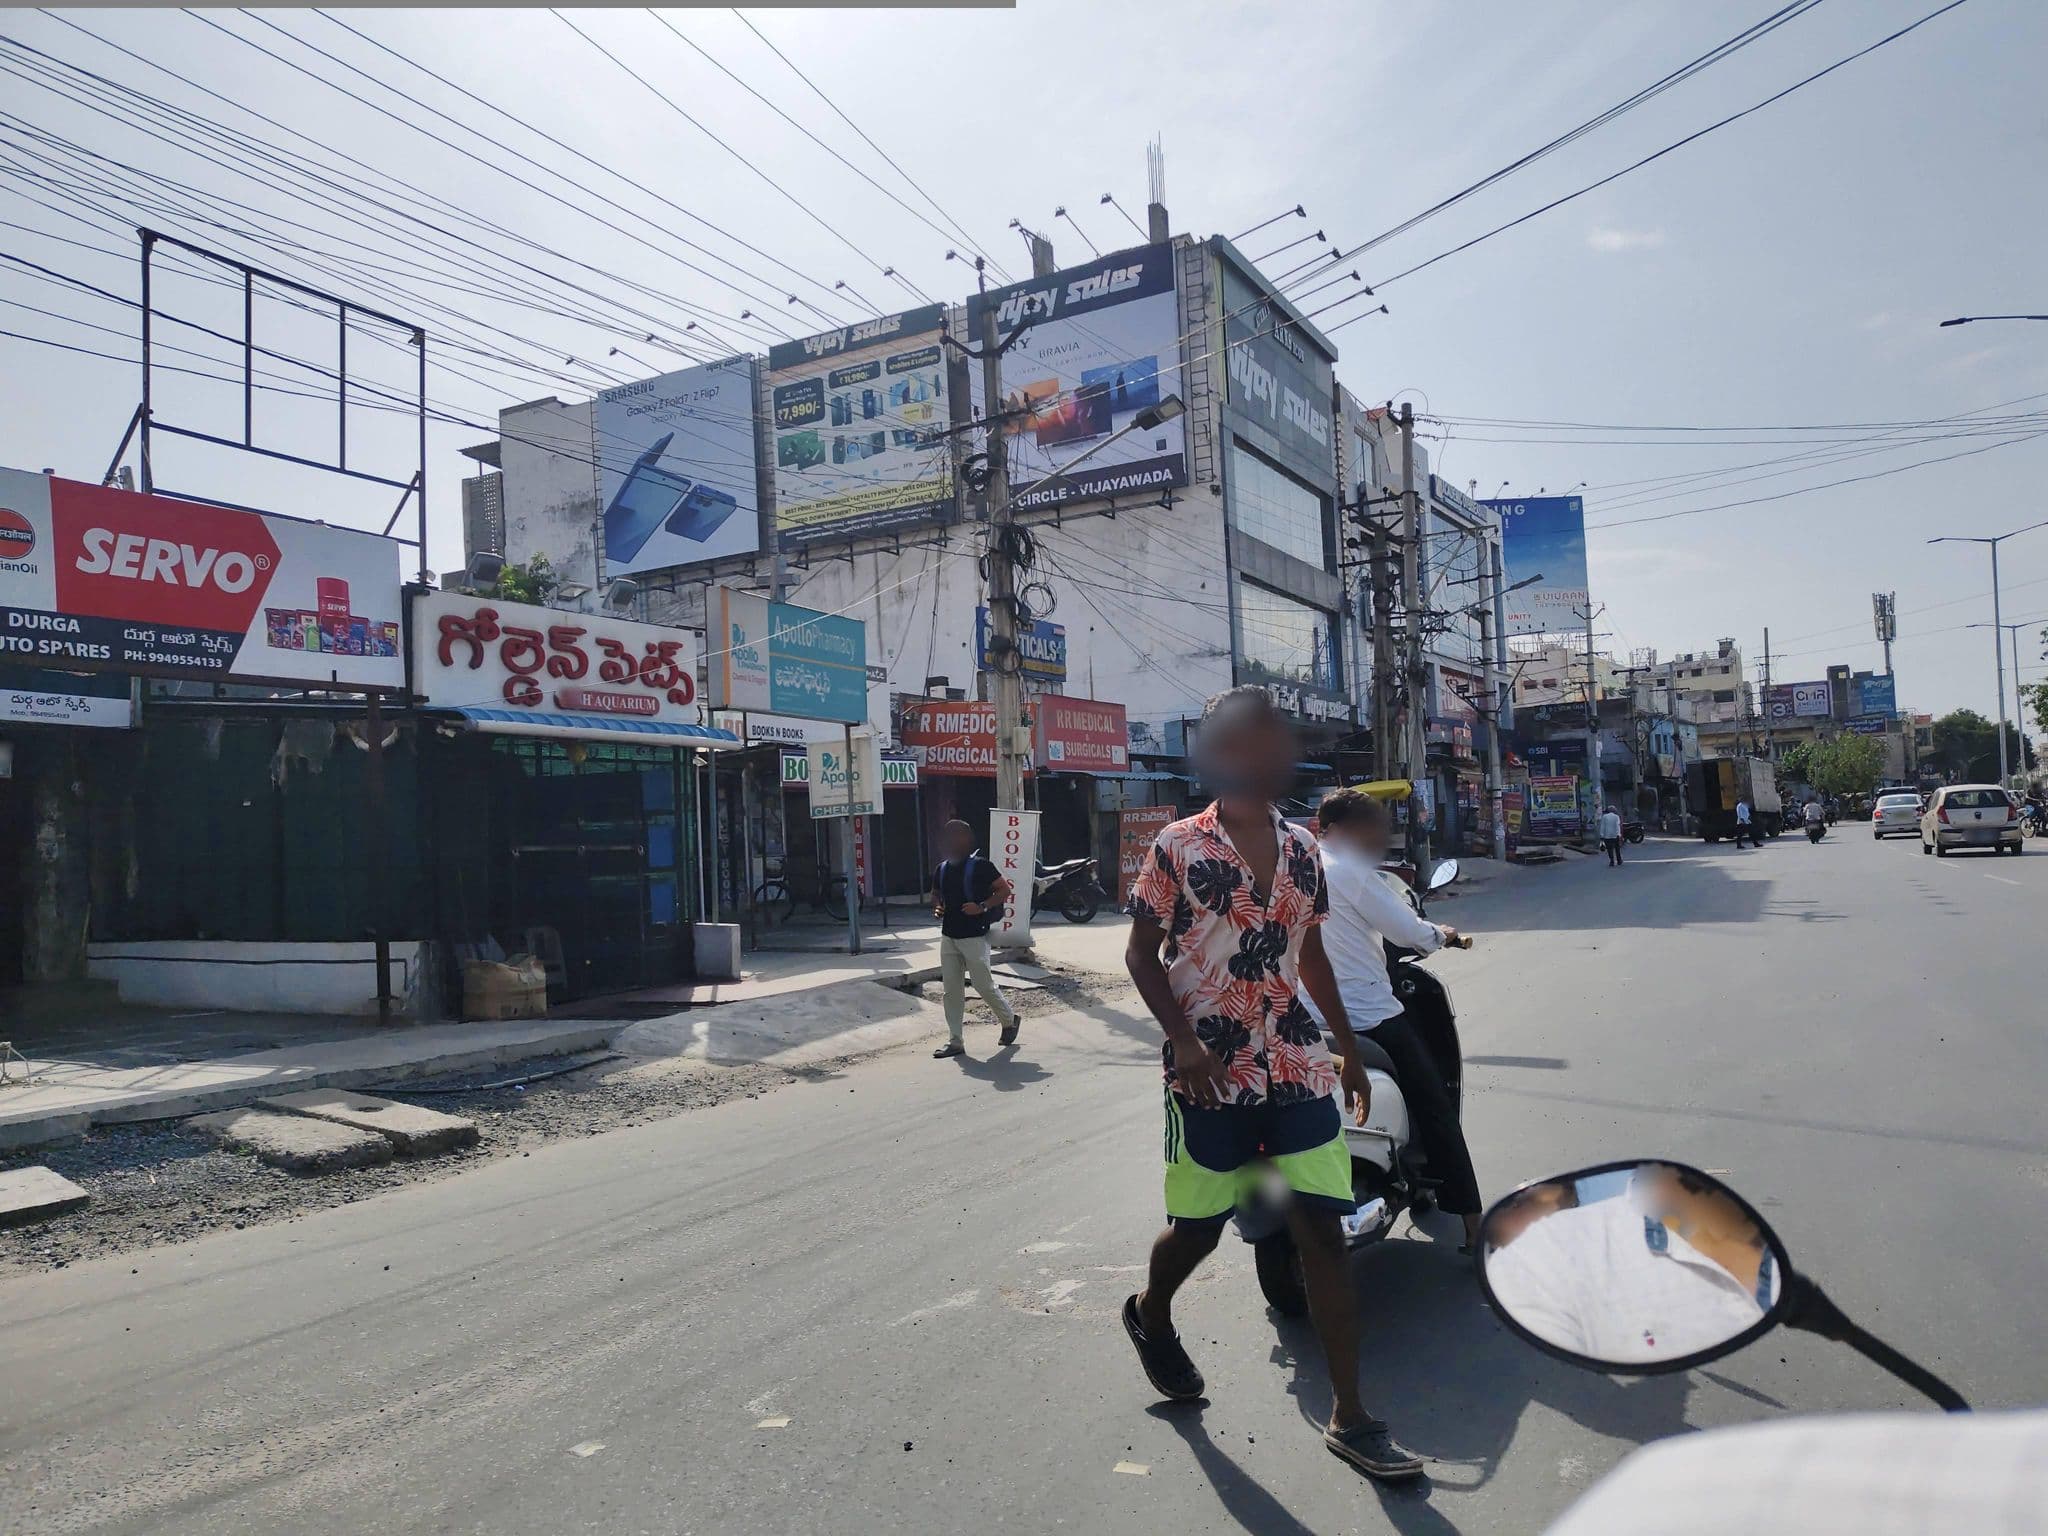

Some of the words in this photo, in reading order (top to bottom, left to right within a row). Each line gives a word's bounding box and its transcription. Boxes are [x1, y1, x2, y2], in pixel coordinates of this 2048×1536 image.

[1065, 264, 1143, 304] sales
[803, 329, 847, 355] vijay
[852, 315, 902, 341] sales
[1039, 342, 1080, 359] BRAVIA
[605, 382, 655, 403] SAMSUNG
[693, 391, 699, 400] Z
[701, 386, 720, 400] Flip7
[1229, 343, 1278, 420] vijay
[1283, 386, 1328, 447] sales
[1018, 487, 1067, 507] CIRCLE
[1079, 468, 1173, 495] VIJAYAWADA
[76, 527, 256, 594] SERVO
[8, 612, 80, 633] DURGA
[38, 639, 111, 659] SPARES
[124, 650, 146, 661] PH:
[149, 652, 223, 668] 9949554133
[594, 696, 657, 714] AQUARIUM
[752, 725, 775, 737] BOOKS
[776, 727, 781, 737] N
[782, 728, 804, 740] BOOKS
[963, 736, 971, 746] &
[928, 748, 997, 764] SURGICAL
[1065, 742, 1111, 759] SURGICALS
[820, 771, 860, 790] Apoo
[815, 803, 871, 816] CHEMST
[1004, 815, 1020, 869] BOOK
